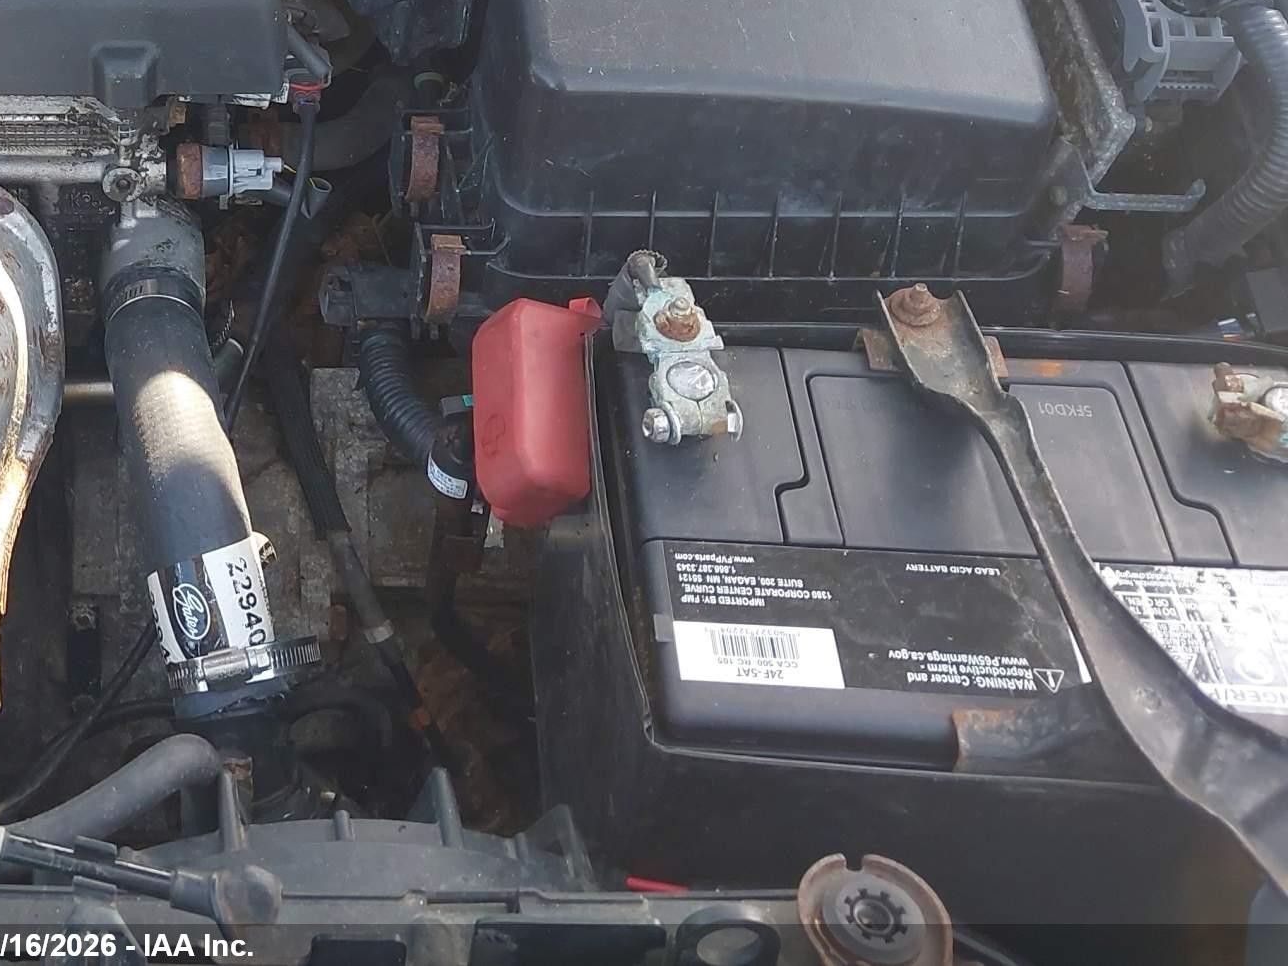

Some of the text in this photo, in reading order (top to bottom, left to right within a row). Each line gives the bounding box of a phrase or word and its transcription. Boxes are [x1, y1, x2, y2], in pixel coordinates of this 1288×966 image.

[675, 553, 754, 564] www.FVPparts.com
[905, 563, 1000, 576] LEAD ACID BATTERY
[707, 575, 720, 583] MN
[722, 575, 755, 585] EAGAN,
[777, 578, 803, 587] SUITE
[681, 583, 714, 593] CURVE,
[717, 585, 752, 595] CENTER
[754, 588, 809, 598] CORPORATE
[235, 557, 266, 646] 22940
[681, 594, 765, 606] IMPORTED BY: FMP
[174, 588, 205, 635] Gates
[888, 649, 1028, 667] www.P65Warnings.ca.gov
[777, 660, 798, 668] CCA
[927, 663, 957, 674] Harm
[736, 668, 784, 679] 24F-5AT
[959, 664, 1033, 678] Reproductive
[907, 672, 1037, 690] WARNING: Cancer and
